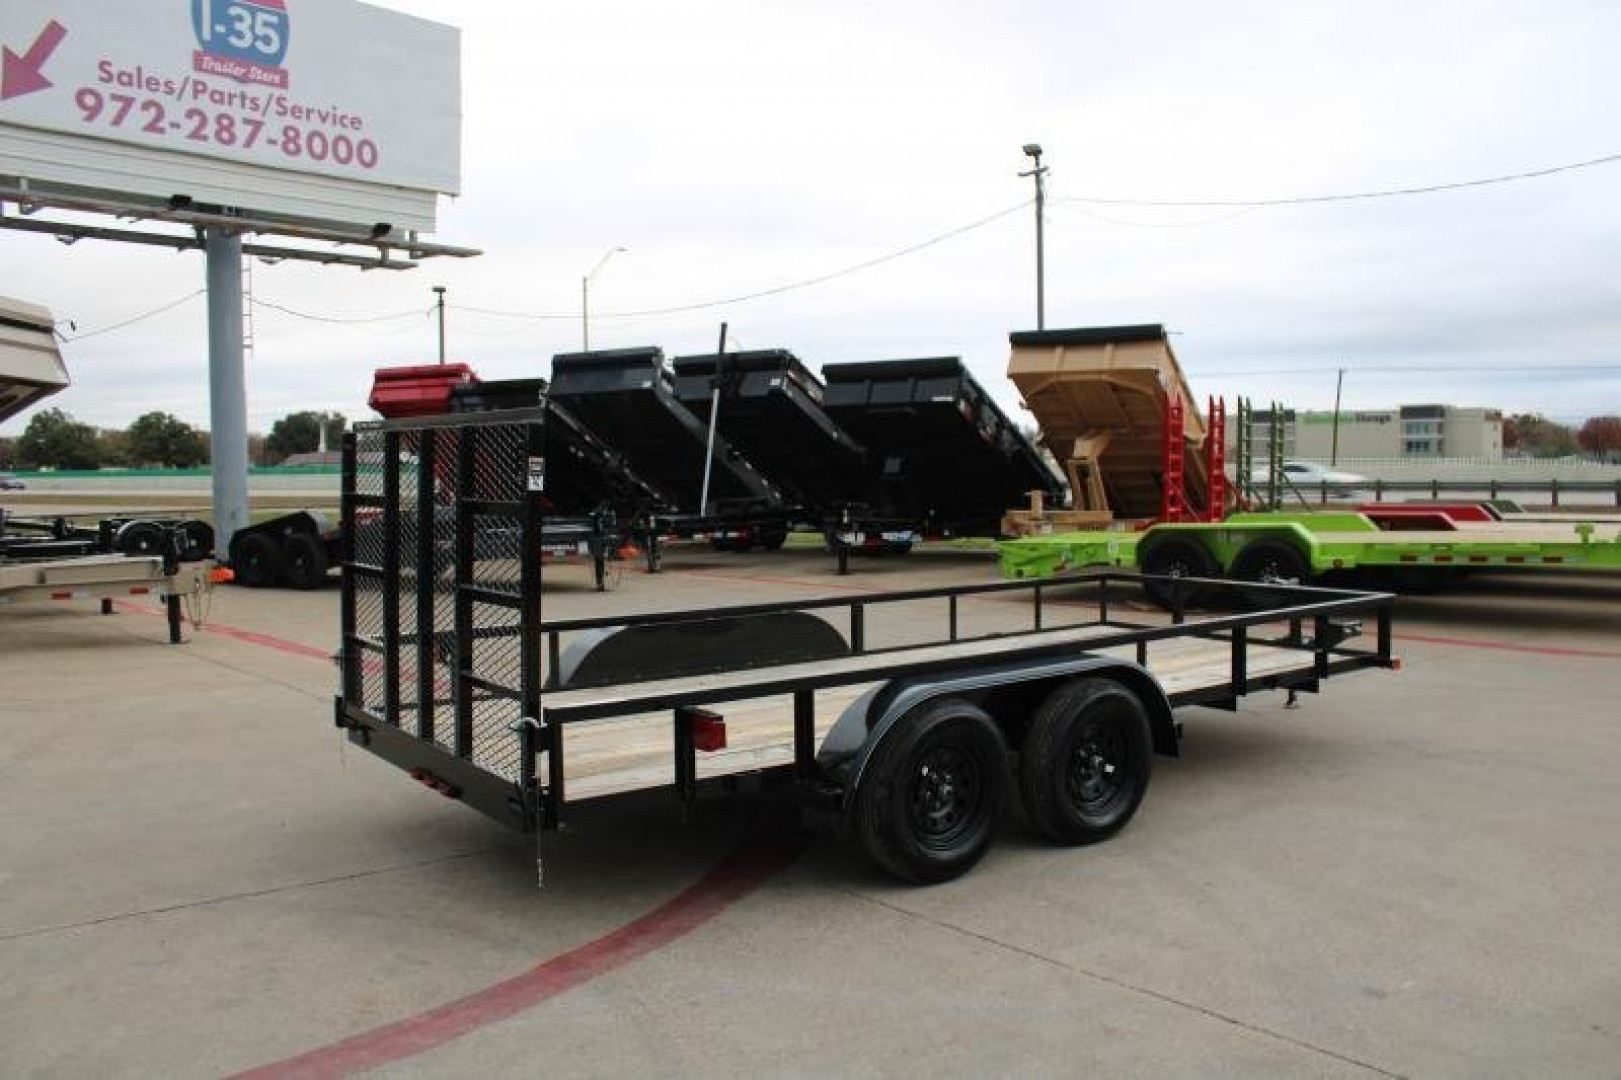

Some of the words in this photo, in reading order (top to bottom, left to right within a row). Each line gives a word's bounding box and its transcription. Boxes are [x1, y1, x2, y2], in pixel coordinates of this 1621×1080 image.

[202, 0, 281, 54] I-35
[74, 86, 379, 169] 972-287-8000
[97, 60, 363, 131] Sales/Parts/Service
